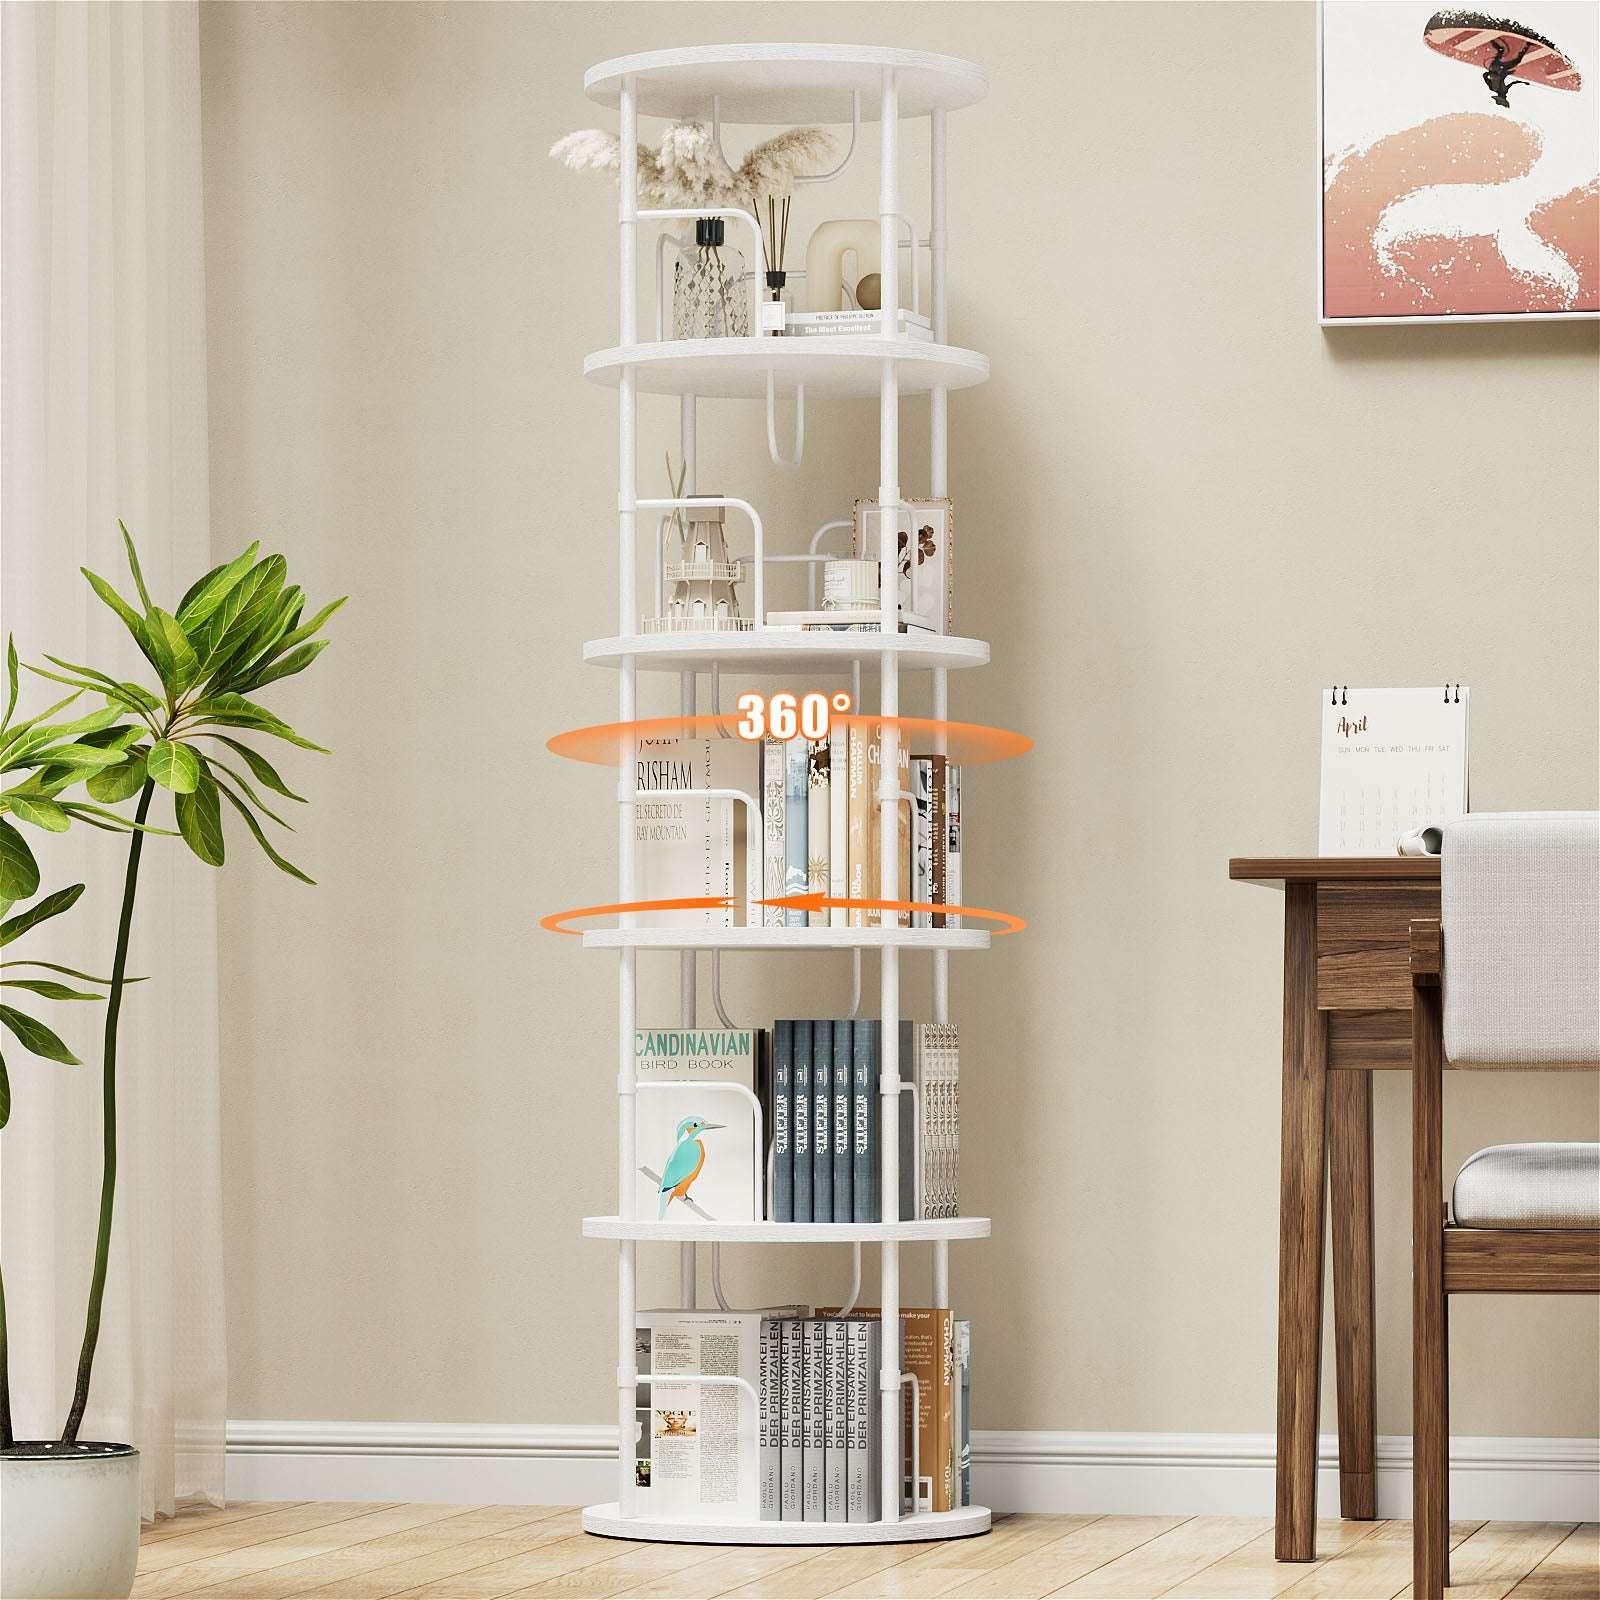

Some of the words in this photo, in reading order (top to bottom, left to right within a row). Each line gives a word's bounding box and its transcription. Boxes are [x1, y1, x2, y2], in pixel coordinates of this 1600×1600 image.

[1336, 714, 1369, 738] April
[867, 743, 909, 769] CHAN
[1337, 745, 1351, 753] SUN
[1355, 745, 1370, 753] MON
[1438, 744, 1450, 752] SAT
[636, 760, 693, 790] RISHAM
[636, 825, 648, 841] RAY
[635, 1031, 750, 1057] CANDINAVIAN
[640, 1059, 679, 1070] BIRD
[687, 1059, 735, 1070] BOOK
[777, 1094, 785, 1154] STIFTER
[797, 1094, 805, 1154] STIFTER
[816, 1094, 824, 1154] STIFTER
[836, 1094, 844, 1154] STIFTER
[856, 1094, 864, 1154] STIFTER
[770, 1321, 778, 1413] PRIMZAHLEN
[791, 1322, 800, 1414] PRIMZAHLEN
[803, 1337, 811, 1421] EINSAMKEIT
[814, 1322, 822, 1414] PRIMZAHLEN
[825, 1337, 833, 1421] EINSAMKEIT
[836, 1323, 844, 1415] PRIMZAHLEN
[847, 1337, 855, 1421] EINSAMKEIT
[858, 1323, 866, 1415] PRIMZAHLEN
[770, 1419, 778, 1448] DER
[791, 1419, 800, 1448] DER
[803, 1426, 811, 1448] DIE
[814, 1420, 822, 1448] DER
[825, 1426, 833, 1448] DIE
[836, 1420, 844, 1449] DER
[847, 1427, 855, 1449] DIE
[858, 1421, 866, 1449] DER
